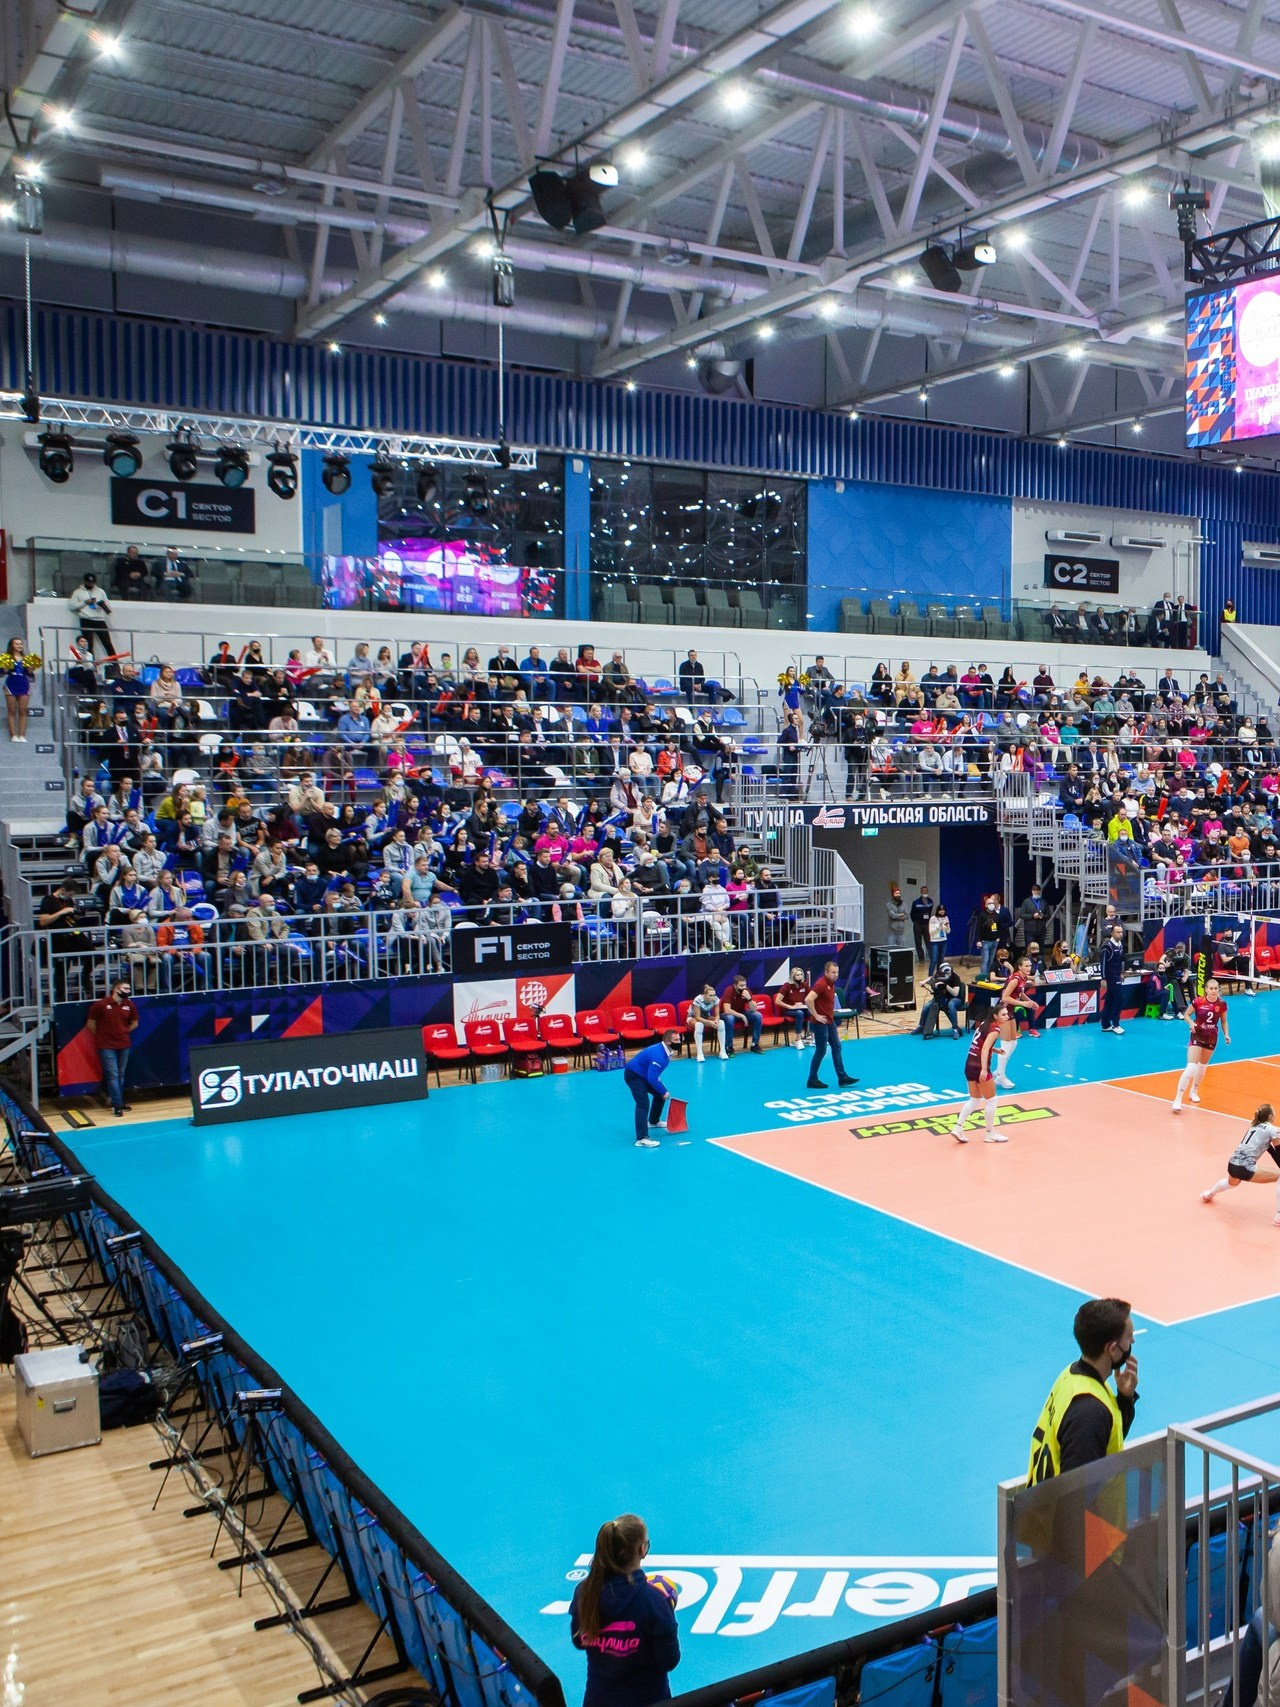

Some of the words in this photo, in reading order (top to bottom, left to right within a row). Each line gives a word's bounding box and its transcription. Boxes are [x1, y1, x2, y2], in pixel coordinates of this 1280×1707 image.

[136, 488, 187, 520] C1
[192, 502, 232, 511] СЕКТОР
[192, 513, 232, 522] SECTOR
[1054, 562, 1088, 584] C2
[852, 806, 924, 825] ТУЛЬСКАЯ
[929, 805, 988, 823] ОБЛАСТЬ
[474, 936, 513, 963] F1
[516, 942, 550, 950] СЕКТОР
[517, 952, 550, 961] SECTOR
[1206, 1011, 1214, 1023] 2
[243, 1058, 418, 1095] ТУЛАТОЧМАШ
